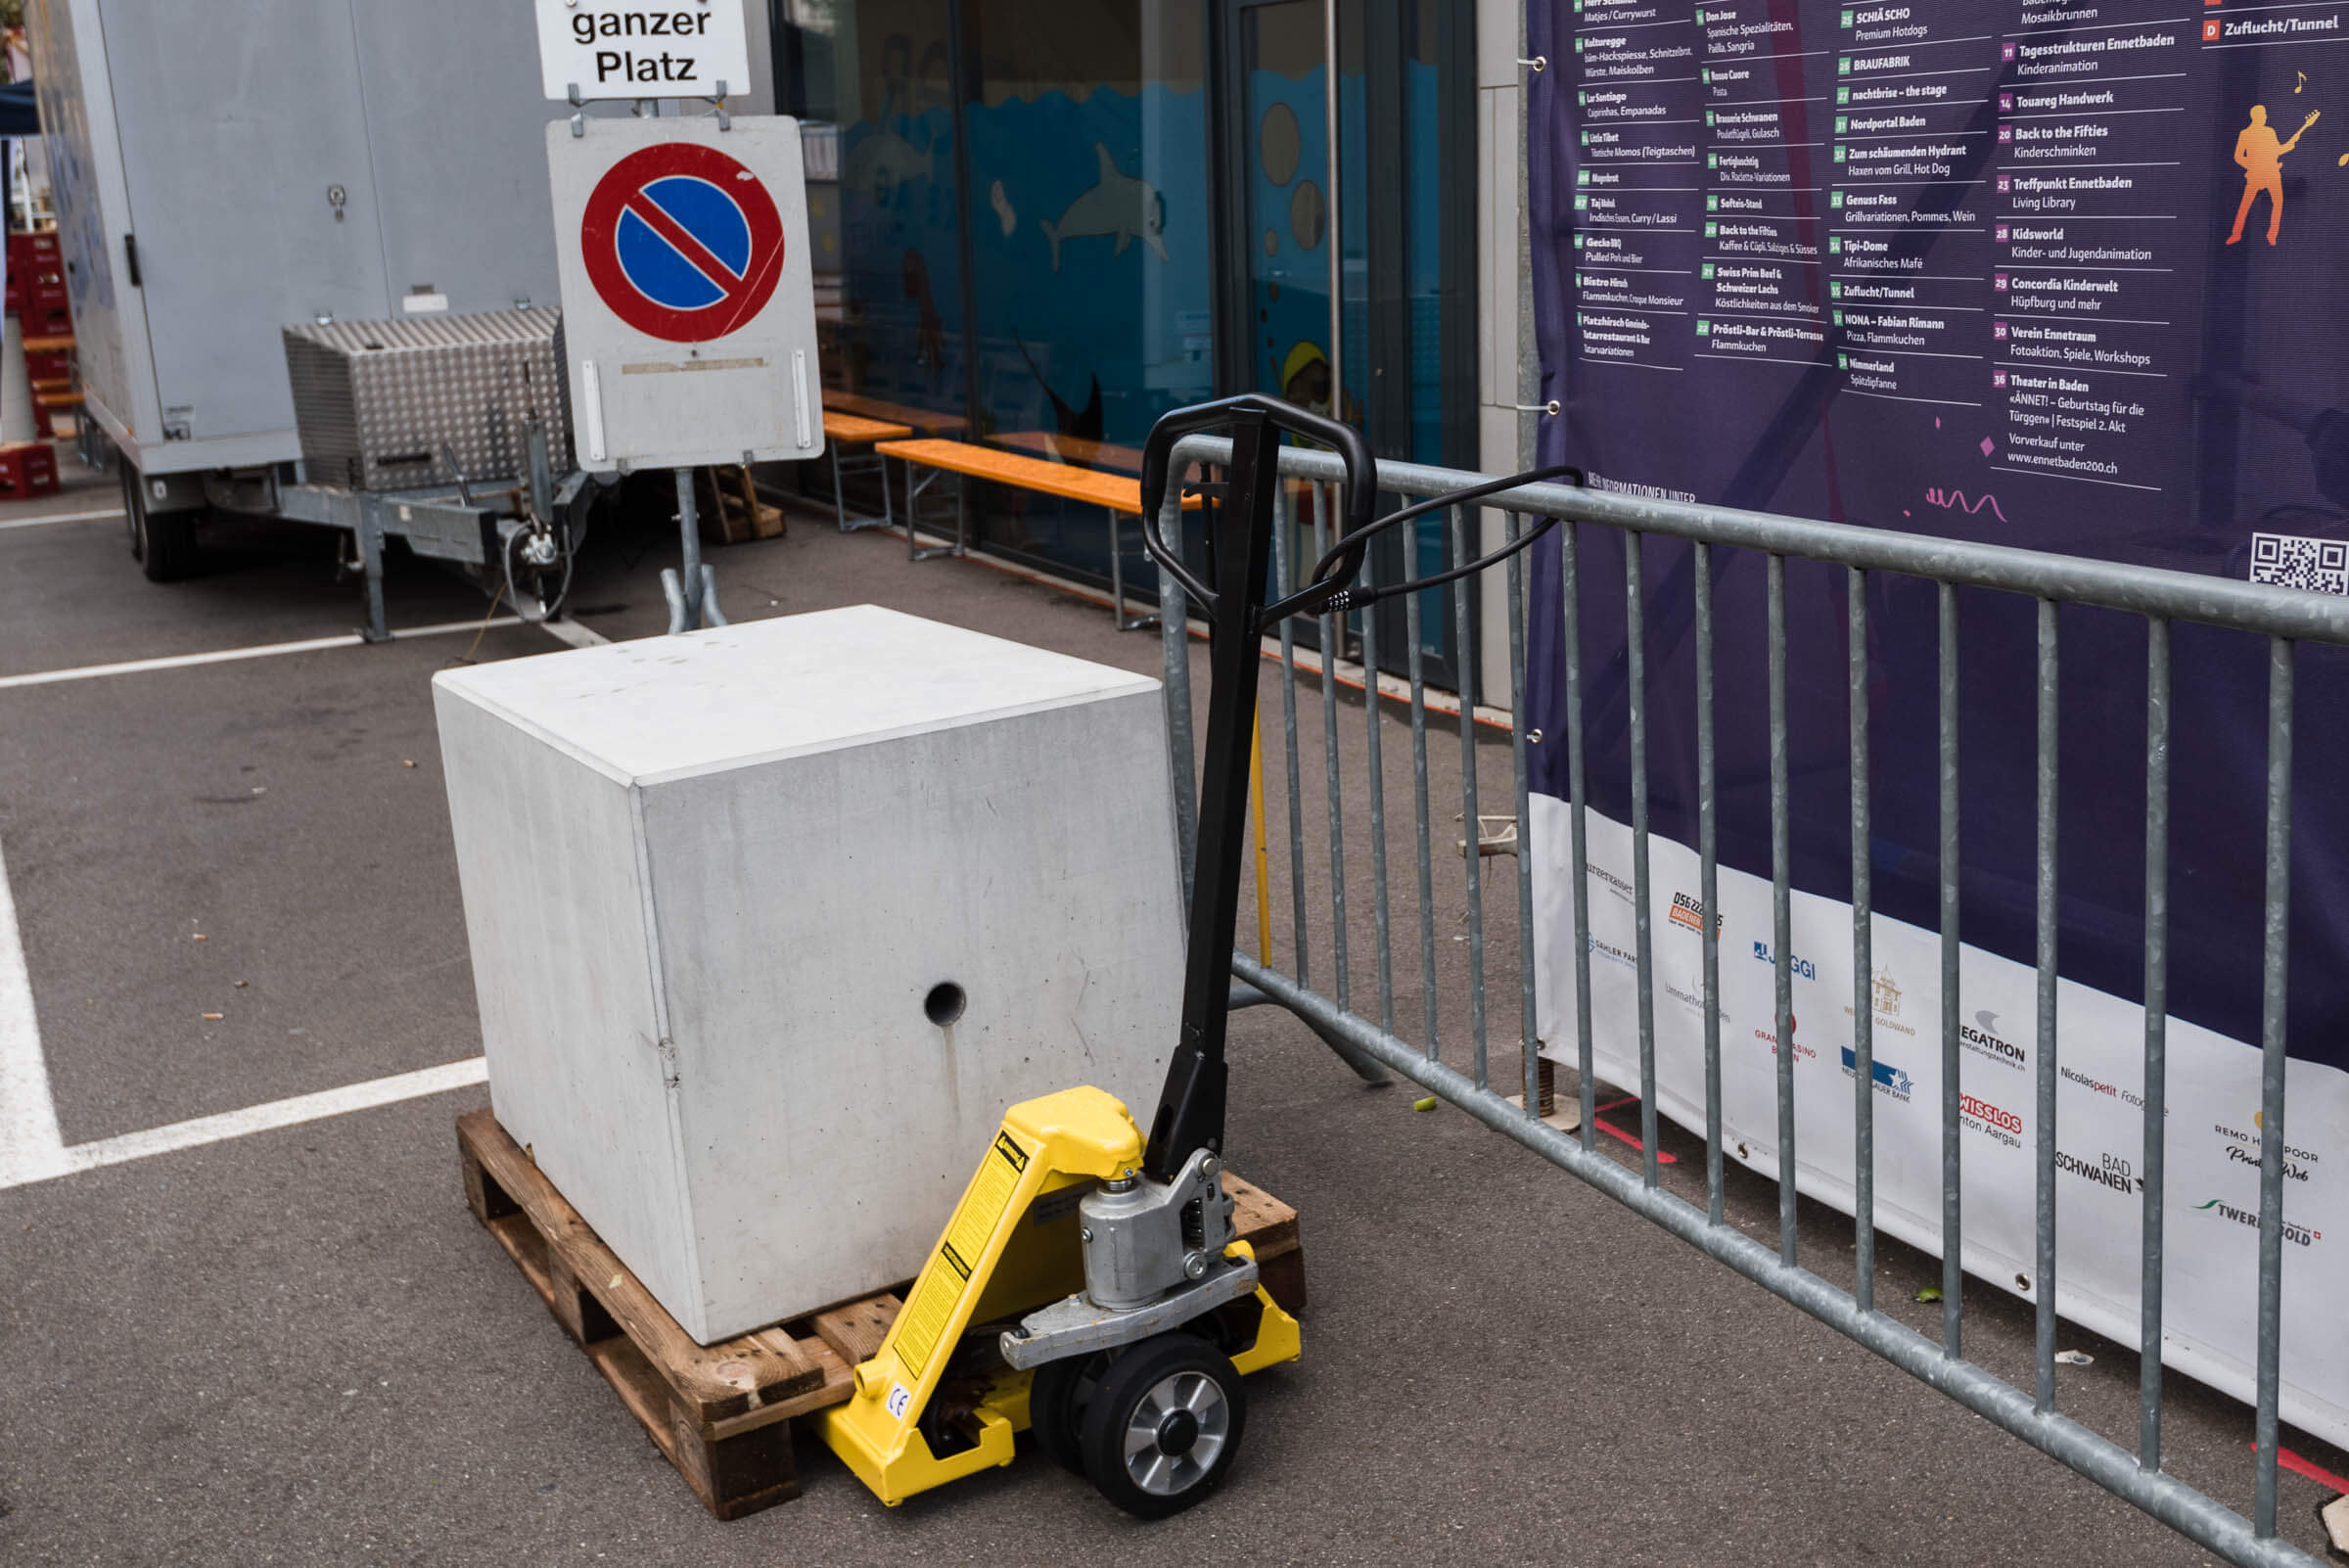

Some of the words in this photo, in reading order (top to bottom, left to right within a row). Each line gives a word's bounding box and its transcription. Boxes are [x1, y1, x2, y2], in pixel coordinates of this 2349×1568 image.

[1612, 8, 1656, 21] Currywurst
[2021, 8, 2098, 24] Mosaikbrunnen
[572, 9, 712, 44] ganzer
[1706, 25, 1739, 39] Spanische
[1739, 22, 1794, 36] Spezialitäten,
[1856, 27, 1891, 42] Premium
[1892, 23, 1928, 38] Hotdogs
[2206, 24, 2217, 37] D
[2224, 15, 2339, 37] Zuflucht/Tunnel
[1727, 40, 1755, 54] Sangria
[2004, 49, 2013, 58] 11
[2019, 40, 2105, 60] Tagesstrukturen
[2106, 33, 2175, 51] Ennetbaden
[595, 51, 699, 82] Platz
[1608, 64, 1654, 75] Maiskolben
[1854, 55, 1911, 71] BRAUFABRIK
[2017, 60, 2098, 75] Kinderanimation
[1728, 69, 1750, 80] Cuore
[1595, 91, 1627, 104] Santiago
[1852, 86, 1898, 102] nachtbrise
[1906, 84, 1921, 97] the
[1921, 85, 1948, 99] stage
[2001, 99, 2011, 110] 14
[2016, 95, 2057, 110] Touareg
[2058, 90, 2114, 107] Handwerk
[1620, 105, 1667, 116] Empanadas
[1740, 111, 1778, 123] Schwanen
[1851, 115, 1899, 132] Nordportal
[1899, 115, 1926, 127] Baden
[1751, 126, 1780, 139] Gulasch
[1999, 130, 2011, 141] 20
[2015, 127, 2041, 140] Back
[2042, 128, 2053, 139] to
[2054, 126, 2073, 139] the
[2074, 124, 2109, 138] Fifties
[1614, 146, 1641, 158] Momos
[1641, 145, 1695, 159] (Teigtaschen)
[1849, 148, 1867, 160] Zum
[1868, 145, 1927, 159] schäumenden
[1928, 144, 1966, 159] Hydrant
[2013, 144, 2097, 159] Kinderschminken
[1848, 164, 1873, 176] Haxen
[1874, 166, 1892, 176] vom
[1893, 162, 1912, 175] Grill,
[1913, 162, 1930, 174] Hot
[1931, 161, 1951, 177] Dog
[1998, 180, 2009, 191] 23
[2013, 177, 2068, 193] Treffpunkt
[2068, 176, 2133, 190] Ennetbaden
[1846, 194, 1877, 206] Genuss
[1878, 194, 1898, 206] Fass
[2012, 196, 2041, 211] Living
[2042, 196, 2076, 211] Library
[1631, 212, 1652, 226] Curry
[1656, 212, 1678, 224] Lassi
[1845, 210, 1911, 223] Grillvariationen,
[1911, 210, 1952, 223] Pommes,
[1953, 210, 1976, 222] Wein
[1720, 224, 1739, 236] Back
[1739, 225, 1748, 236] to
[1747, 224, 1759, 236] the
[1996, 229, 2008, 240] 28
[2012, 227, 2064, 241] Kidsworld
[1719, 239, 1743, 252] Kaffee
[1844, 240, 1888, 254] Tipi-Dome
[1586, 251, 1610, 262] Pulled
[2011, 247, 2047, 258] Kinder-
[2048, 247, 2067, 259] und
[2067, 247, 2152, 262] Jugendanimation
[1844, 256, 1899, 269] Afrikanisches
[1900, 257, 1924, 270] Mafé
[1717, 266, 1741, 278] Swiss
[1741, 267, 1760, 278] Prim
[1760, 268, 1776, 279] Beef
[1583, 276, 1609, 287] Bistro
[1716, 282, 1758, 295] Schweizer
[1757, 283, 1779, 295] Lachs
[1995, 279, 2007, 290] 29
[2011, 277, 2062, 291] Concordia
[2063, 279, 2119, 294] Kinderwelt
[1647, 295, 1684, 306] Monsieur
[1843, 285, 1915, 300] Zuflucht/Tunnel
[1715, 297, 1770, 310] Köstlichkeiten
[1769, 300, 1782, 311] aus
[1782, 300, 1797, 311] dem
[2010, 296, 2056, 311] Hüpfburg
[2057, 298, 2076, 310] und
[2077, 298, 2102, 311] mehr
[1845, 313, 1870, 327] NONA
[1877, 315, 1909, 328] Fabian
[1909, 317, 1946, 330] Rimann
[1846, 330, 1866, 343] Pizza,
[1866, 332, 1926, 346] Flammkuchen
[1995, 327, 2006, 338] 30
[2011, 326, 2043, 340] Verein
[2044, 328, 2096, 343] Ennetraum
[1711, 339, 1767, 352] Flammkuchen
[2010, 345, 2062, 359] Fotoaktion,
[2063, 347, 2094, 362] Spiele,
[2094, 349, 2151, 368] Workshops
[1849, 358, 1895, 373] Nimmerland
[1850, 373, 1898, 391] Spätzlipfanne
[1994, 375, 2005, 386] 36
[2010, 374, 2048, 390] Theater
[2048, 377, 2057, 390] in
[2058, 379, 2090, 392] Baden
[2057, 396, 2111, 416] Geburtstag
[2111, 401, 2128, 416] für
[2129, 401, 2145, 416] die
[2056, 414, 2097, 432] Festspiel
[2097, 419, 2107, 431] 2.
[2108, 421, 2127, 434] Akt
[2008, 432, 2058, 449] Vorverkauf
[2059, 438, 2086, 452] unter
[2007, 452, 2119, 476] www.ennetbaden200.ch
[1673, 892, 1691, 909] 056
[1768, 948, 1817, 981] JGGI
[1874, 1017, 1915, 1037] GOLDWAND
[1958, 1025, 2026, 1063] EGATRON
[2060, 1066, 2117, 1097] Nicolaspetit
[1958, 1091, 2022, 1134] WISSLOS
[1984, 1125, 2022, 1149] Aargau
[2215, 1125, 2249, 1142] REMO
[2101, 1152, 2132, 1177] BAD
[2055, 1151, 2133, 1195] SCHWANEN
